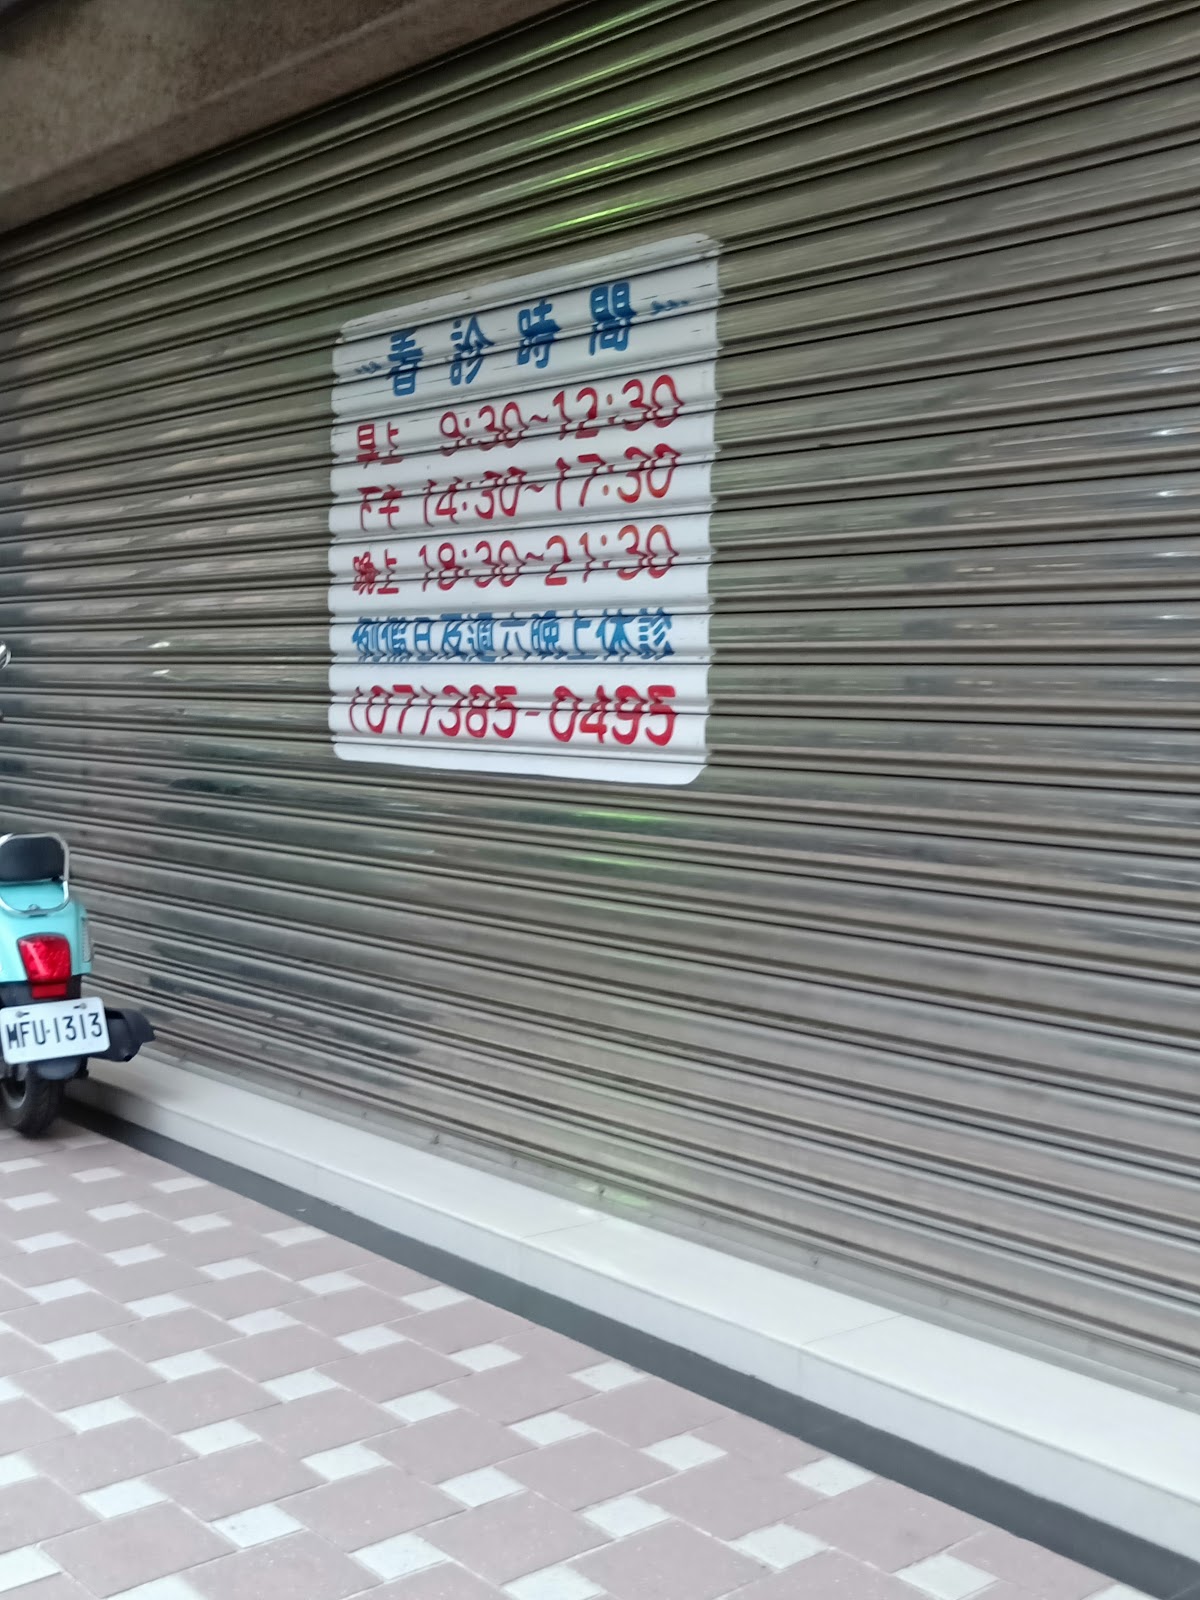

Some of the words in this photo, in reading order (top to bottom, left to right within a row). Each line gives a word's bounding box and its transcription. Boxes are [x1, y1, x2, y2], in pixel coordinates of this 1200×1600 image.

[357, 420, 403, 468] 早上
[440, 374, 685, 457] 9:30~12:30
[357, 484, 403, 532] 下午
[422, 443, 681, 527] 14:30~17:30
[352, 547, 400, 596] 晚上
[418, 524, 679, 592] 18:30~21:30
[349, 684, 678, 747] (07)385-0495
